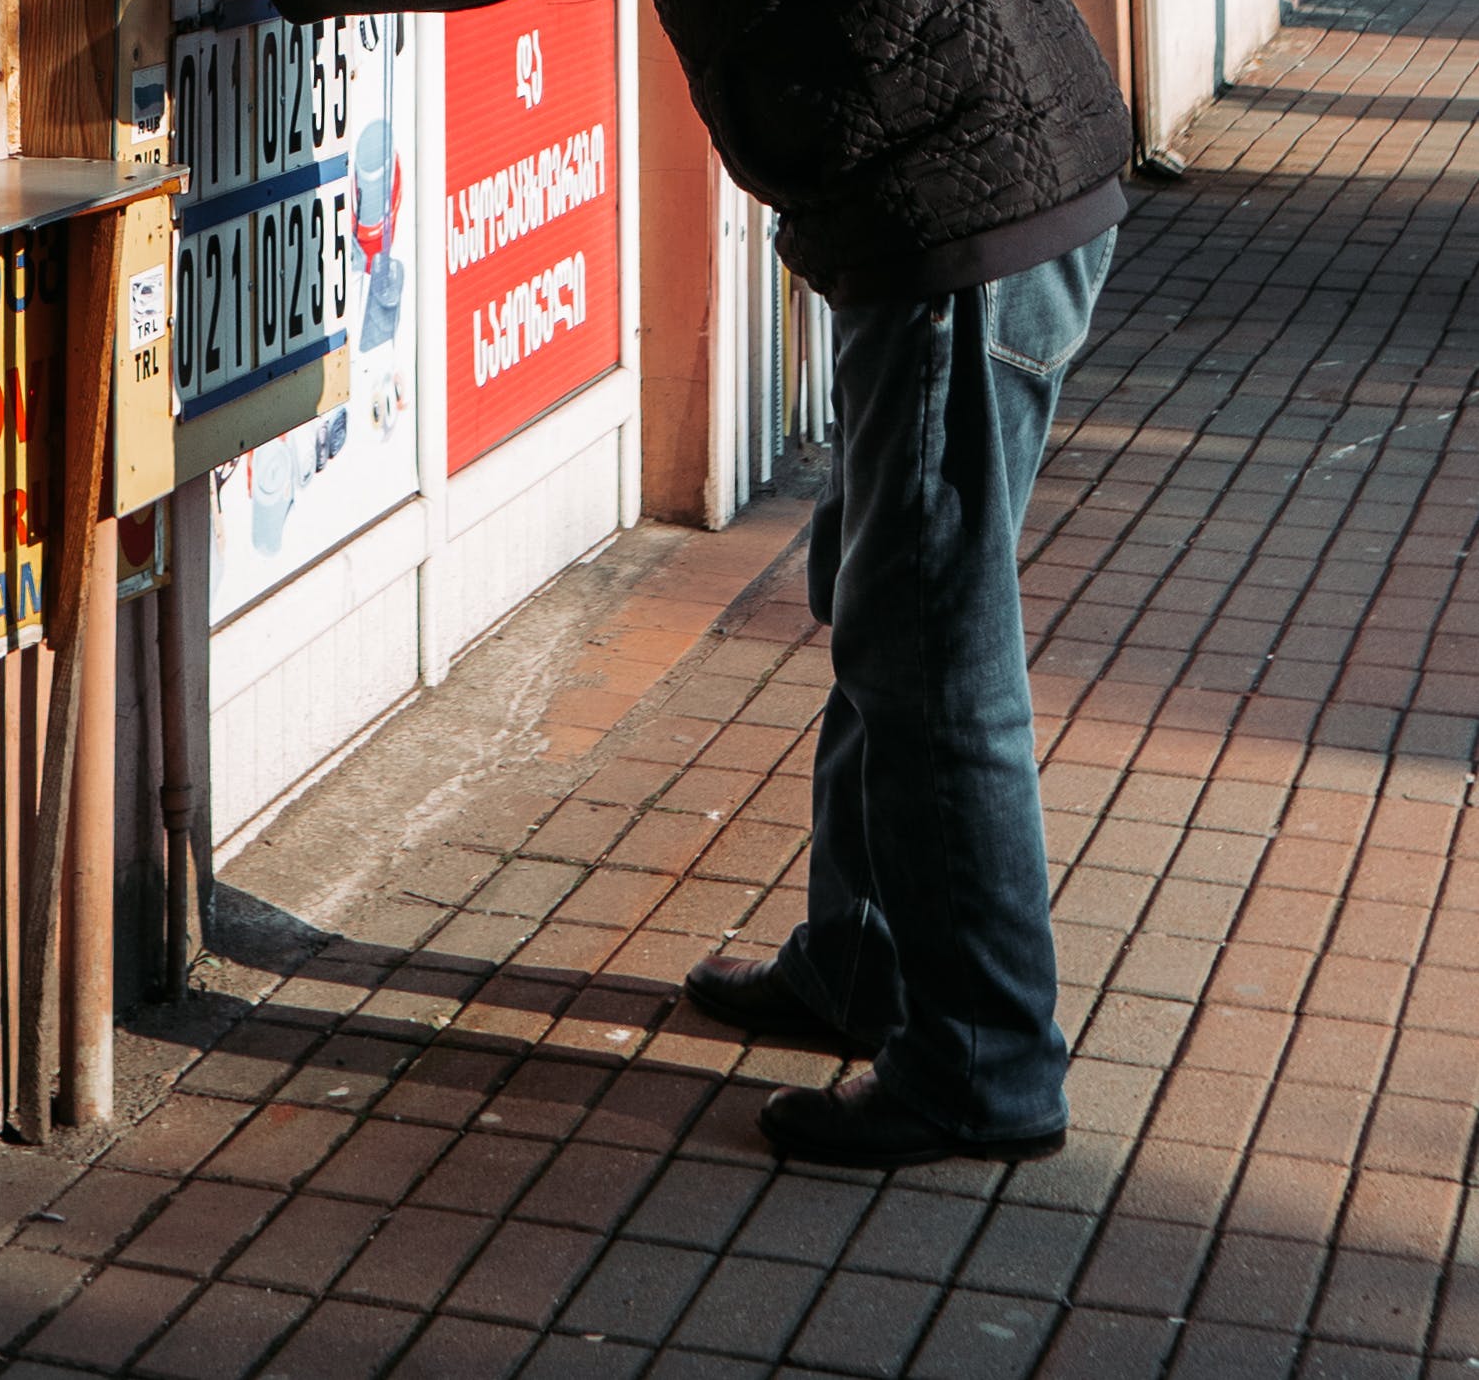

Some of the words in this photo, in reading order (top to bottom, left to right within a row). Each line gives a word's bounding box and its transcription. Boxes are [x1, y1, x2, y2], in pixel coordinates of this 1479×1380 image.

[515, 28, 543, 110] და
[137, 318, 159, 337] TRL
[135, 350, 160, 383] TRL
